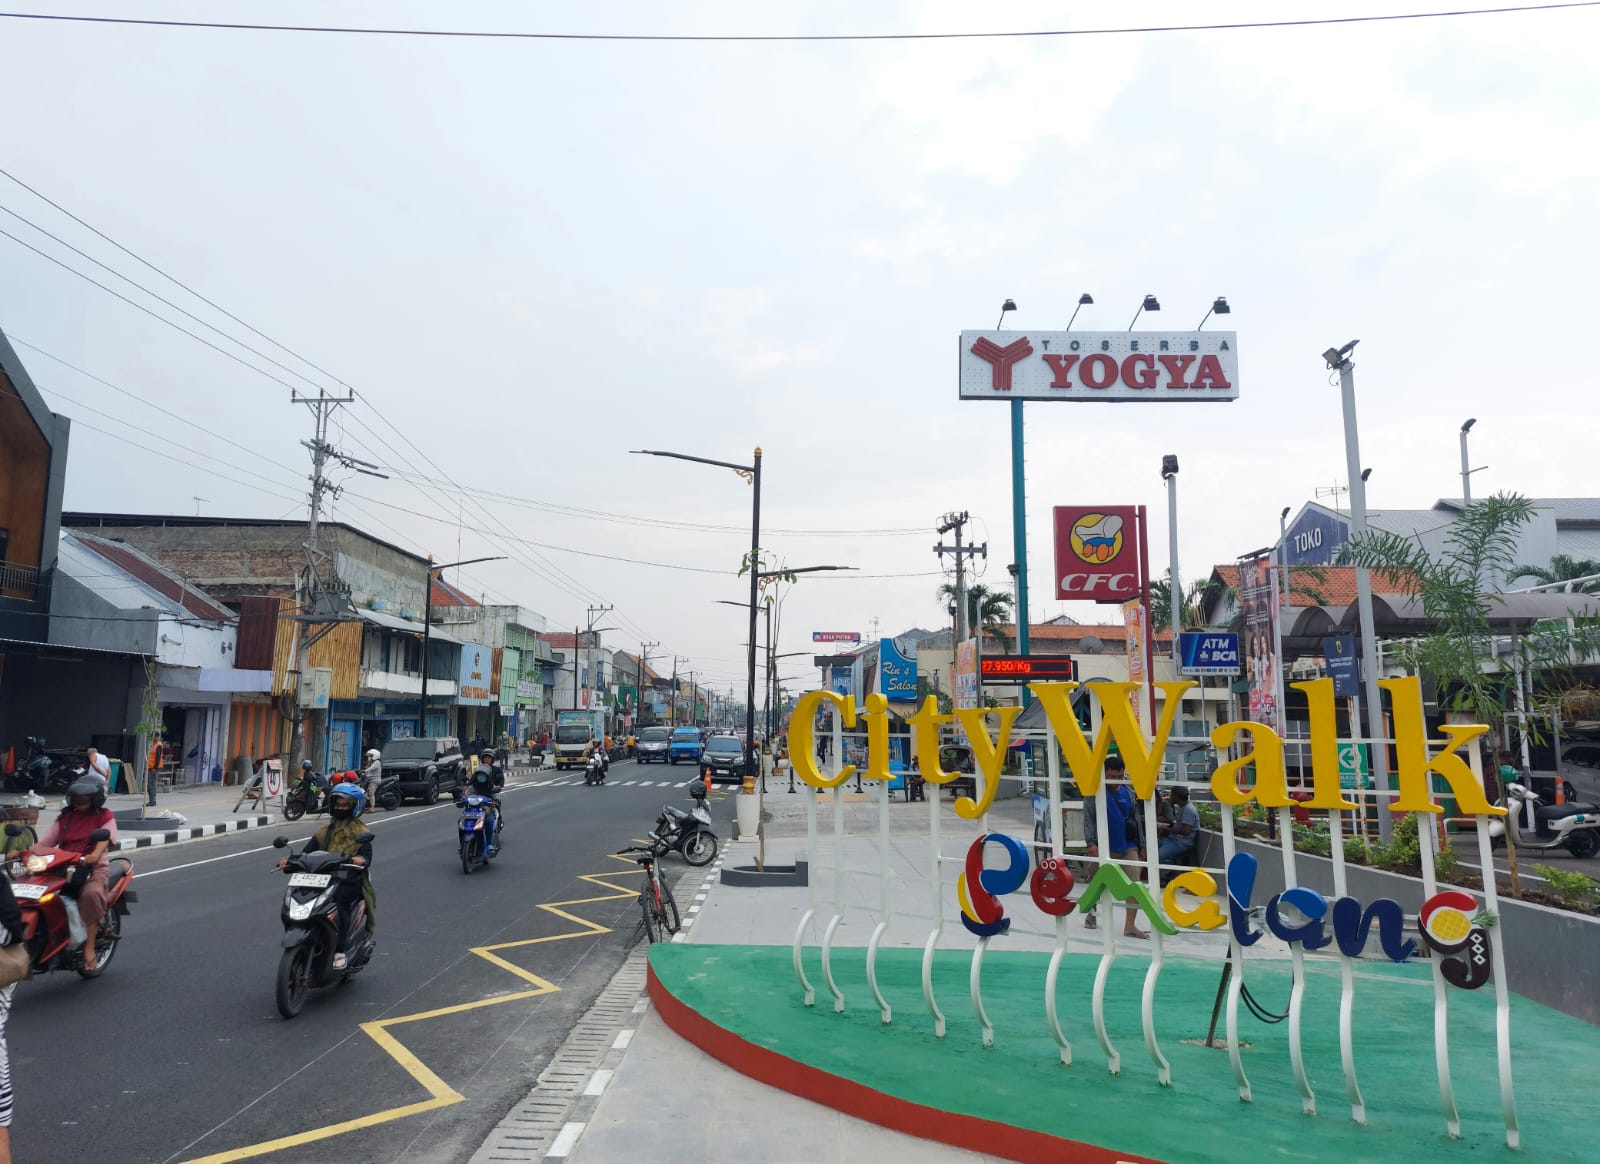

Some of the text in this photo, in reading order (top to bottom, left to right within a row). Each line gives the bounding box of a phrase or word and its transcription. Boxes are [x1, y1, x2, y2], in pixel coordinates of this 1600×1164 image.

[1042, 340, 1230, 351] TOSERBA
[1042, 354, 1232, 389] YOGYA
[1294, 528, 1322, 553] TOKO
[1061, 573, 1135, 592] CFC
[1202, 638, 1229, 649] ATM
[1211, 651, 1236, 661] BCA
[882, 661, 910, 676] Rin's
[887, 677, 918, 691] Salon
